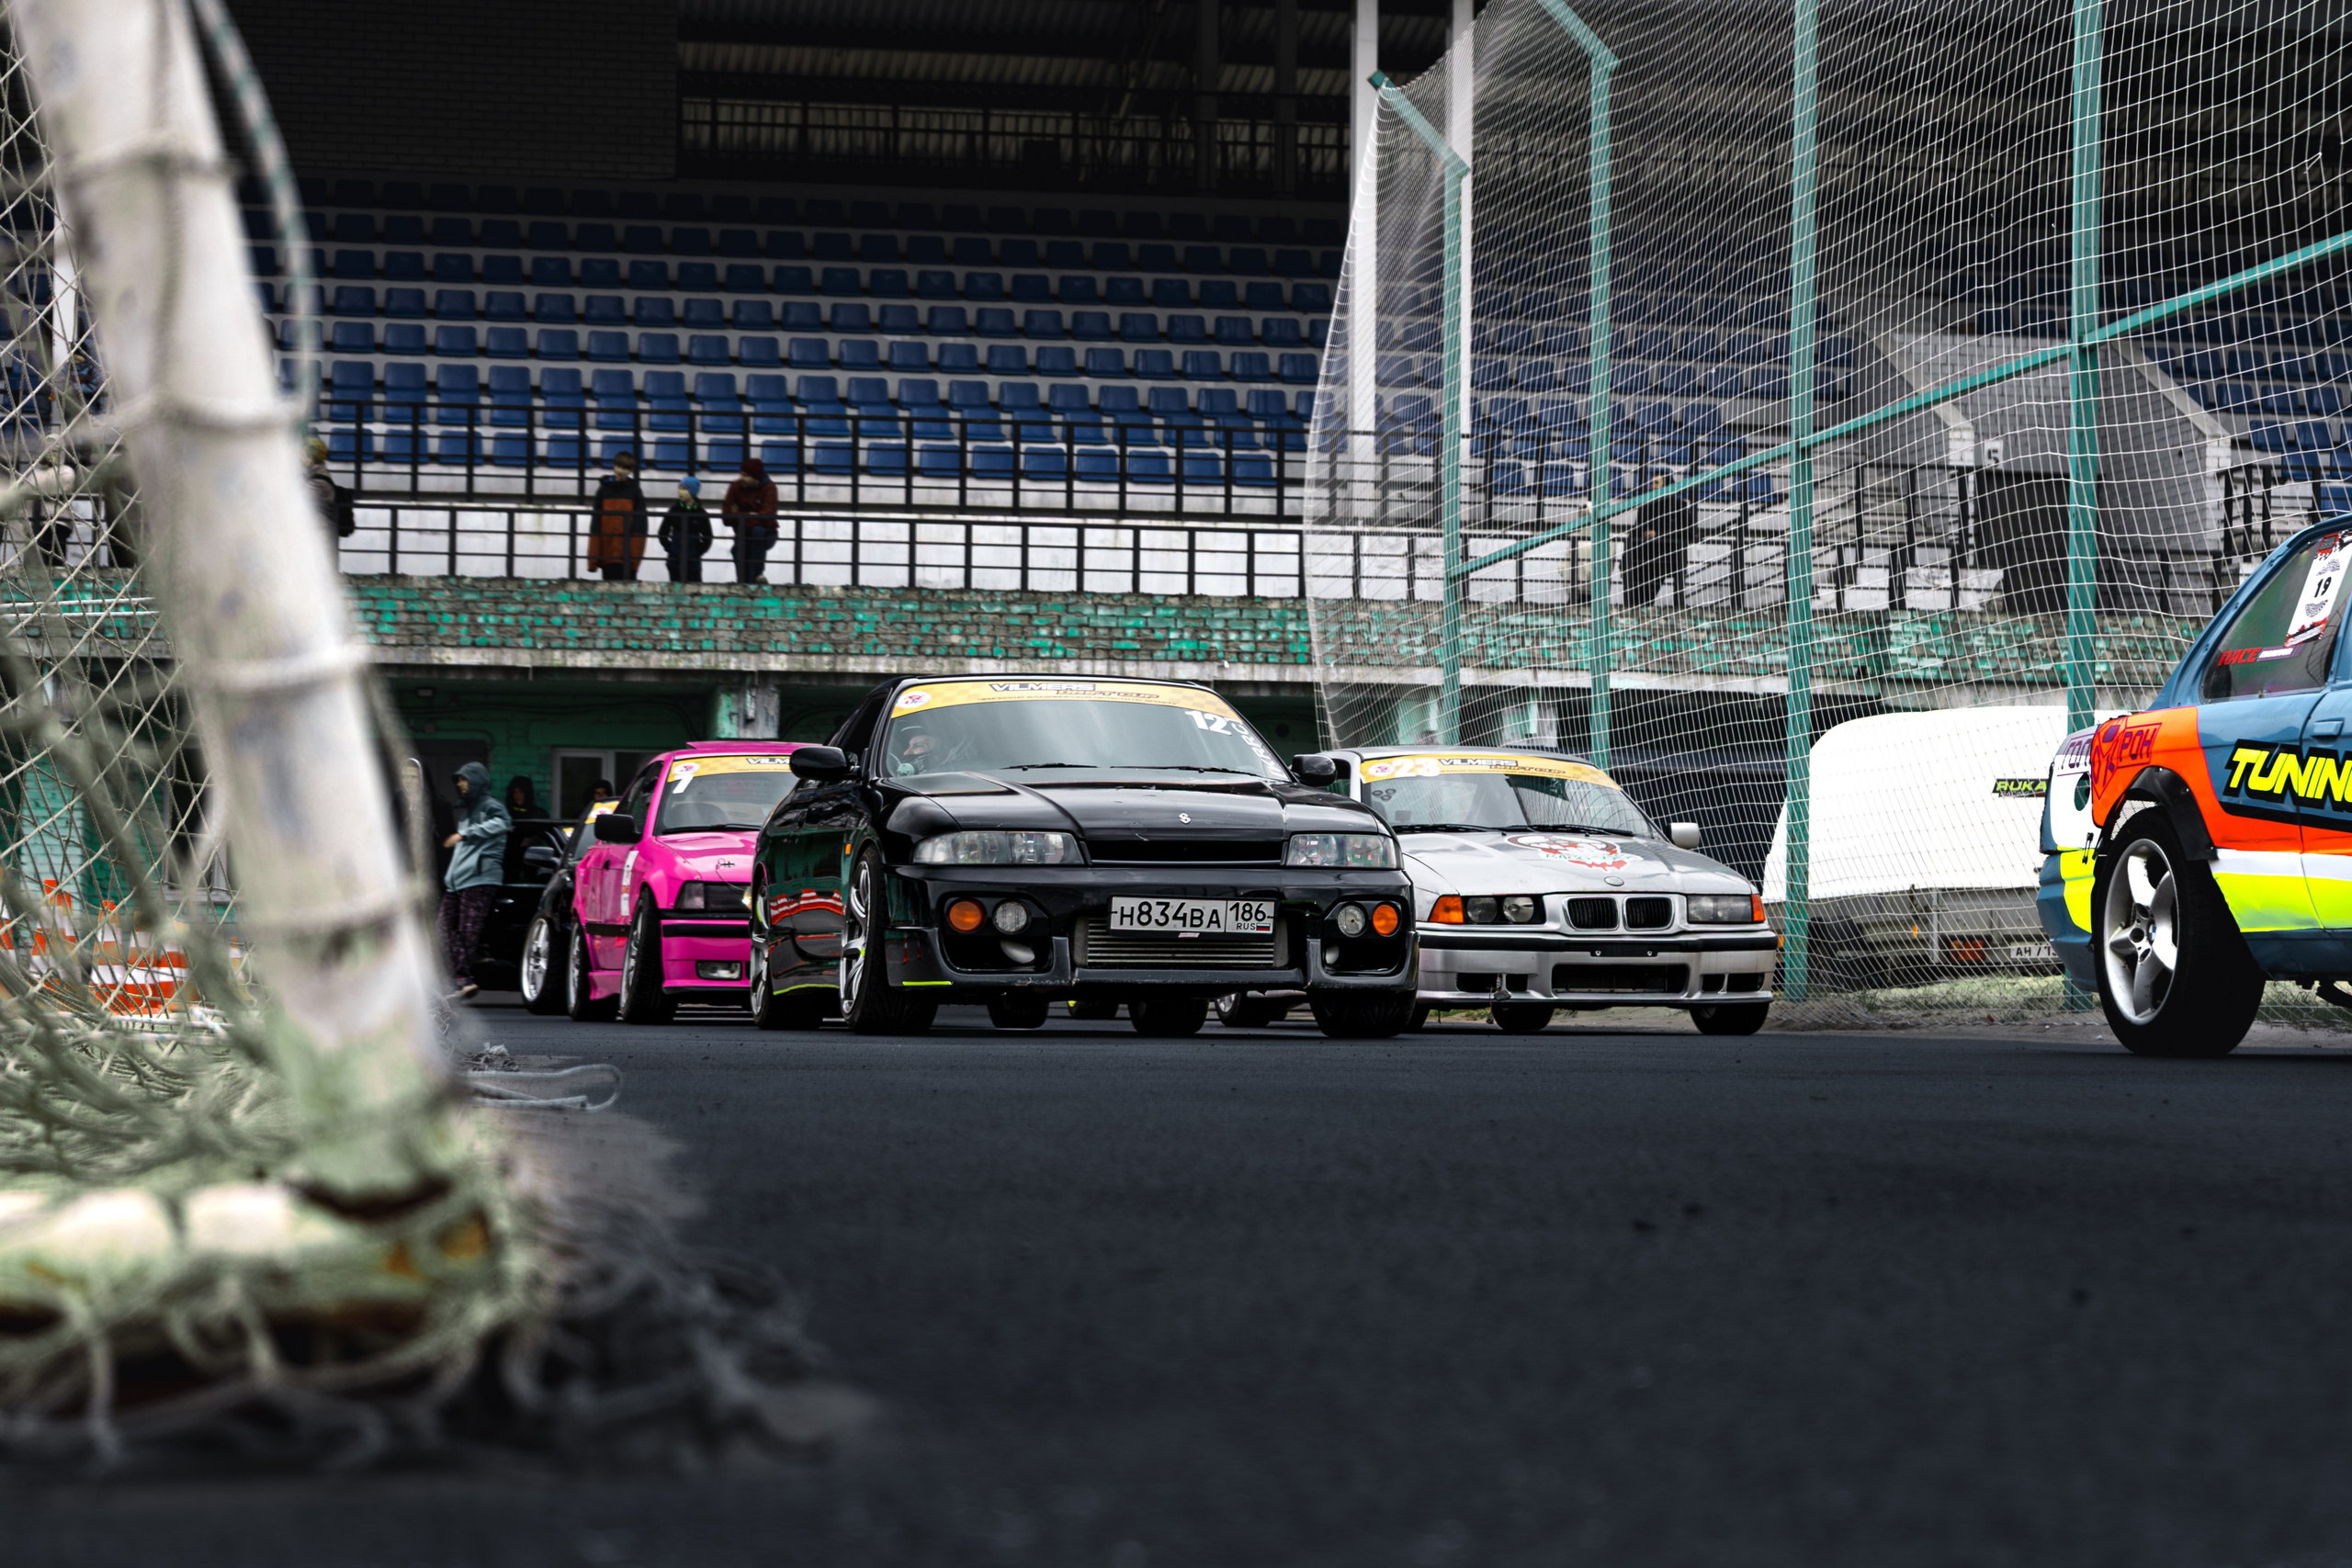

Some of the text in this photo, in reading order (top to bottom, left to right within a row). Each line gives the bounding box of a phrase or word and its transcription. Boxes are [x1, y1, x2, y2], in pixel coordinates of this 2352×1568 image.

[2314, 576, 2333, 598] 19
[2218, 647, 2263, 667] RACE
[989, 682, 1096, 692] VILMERS
[1185, 710, 1232, 736] 12
[1393, 757, 1442, 778] 23
[1438, 758, 1518, 767] VILMERS
[673, 773, 695, 795] 7
[1996, 780, 2047, 791] RUKA
[1119, 900, 1267, 929] H834BA 186
[1236, 922, 1256, 931] RUS
